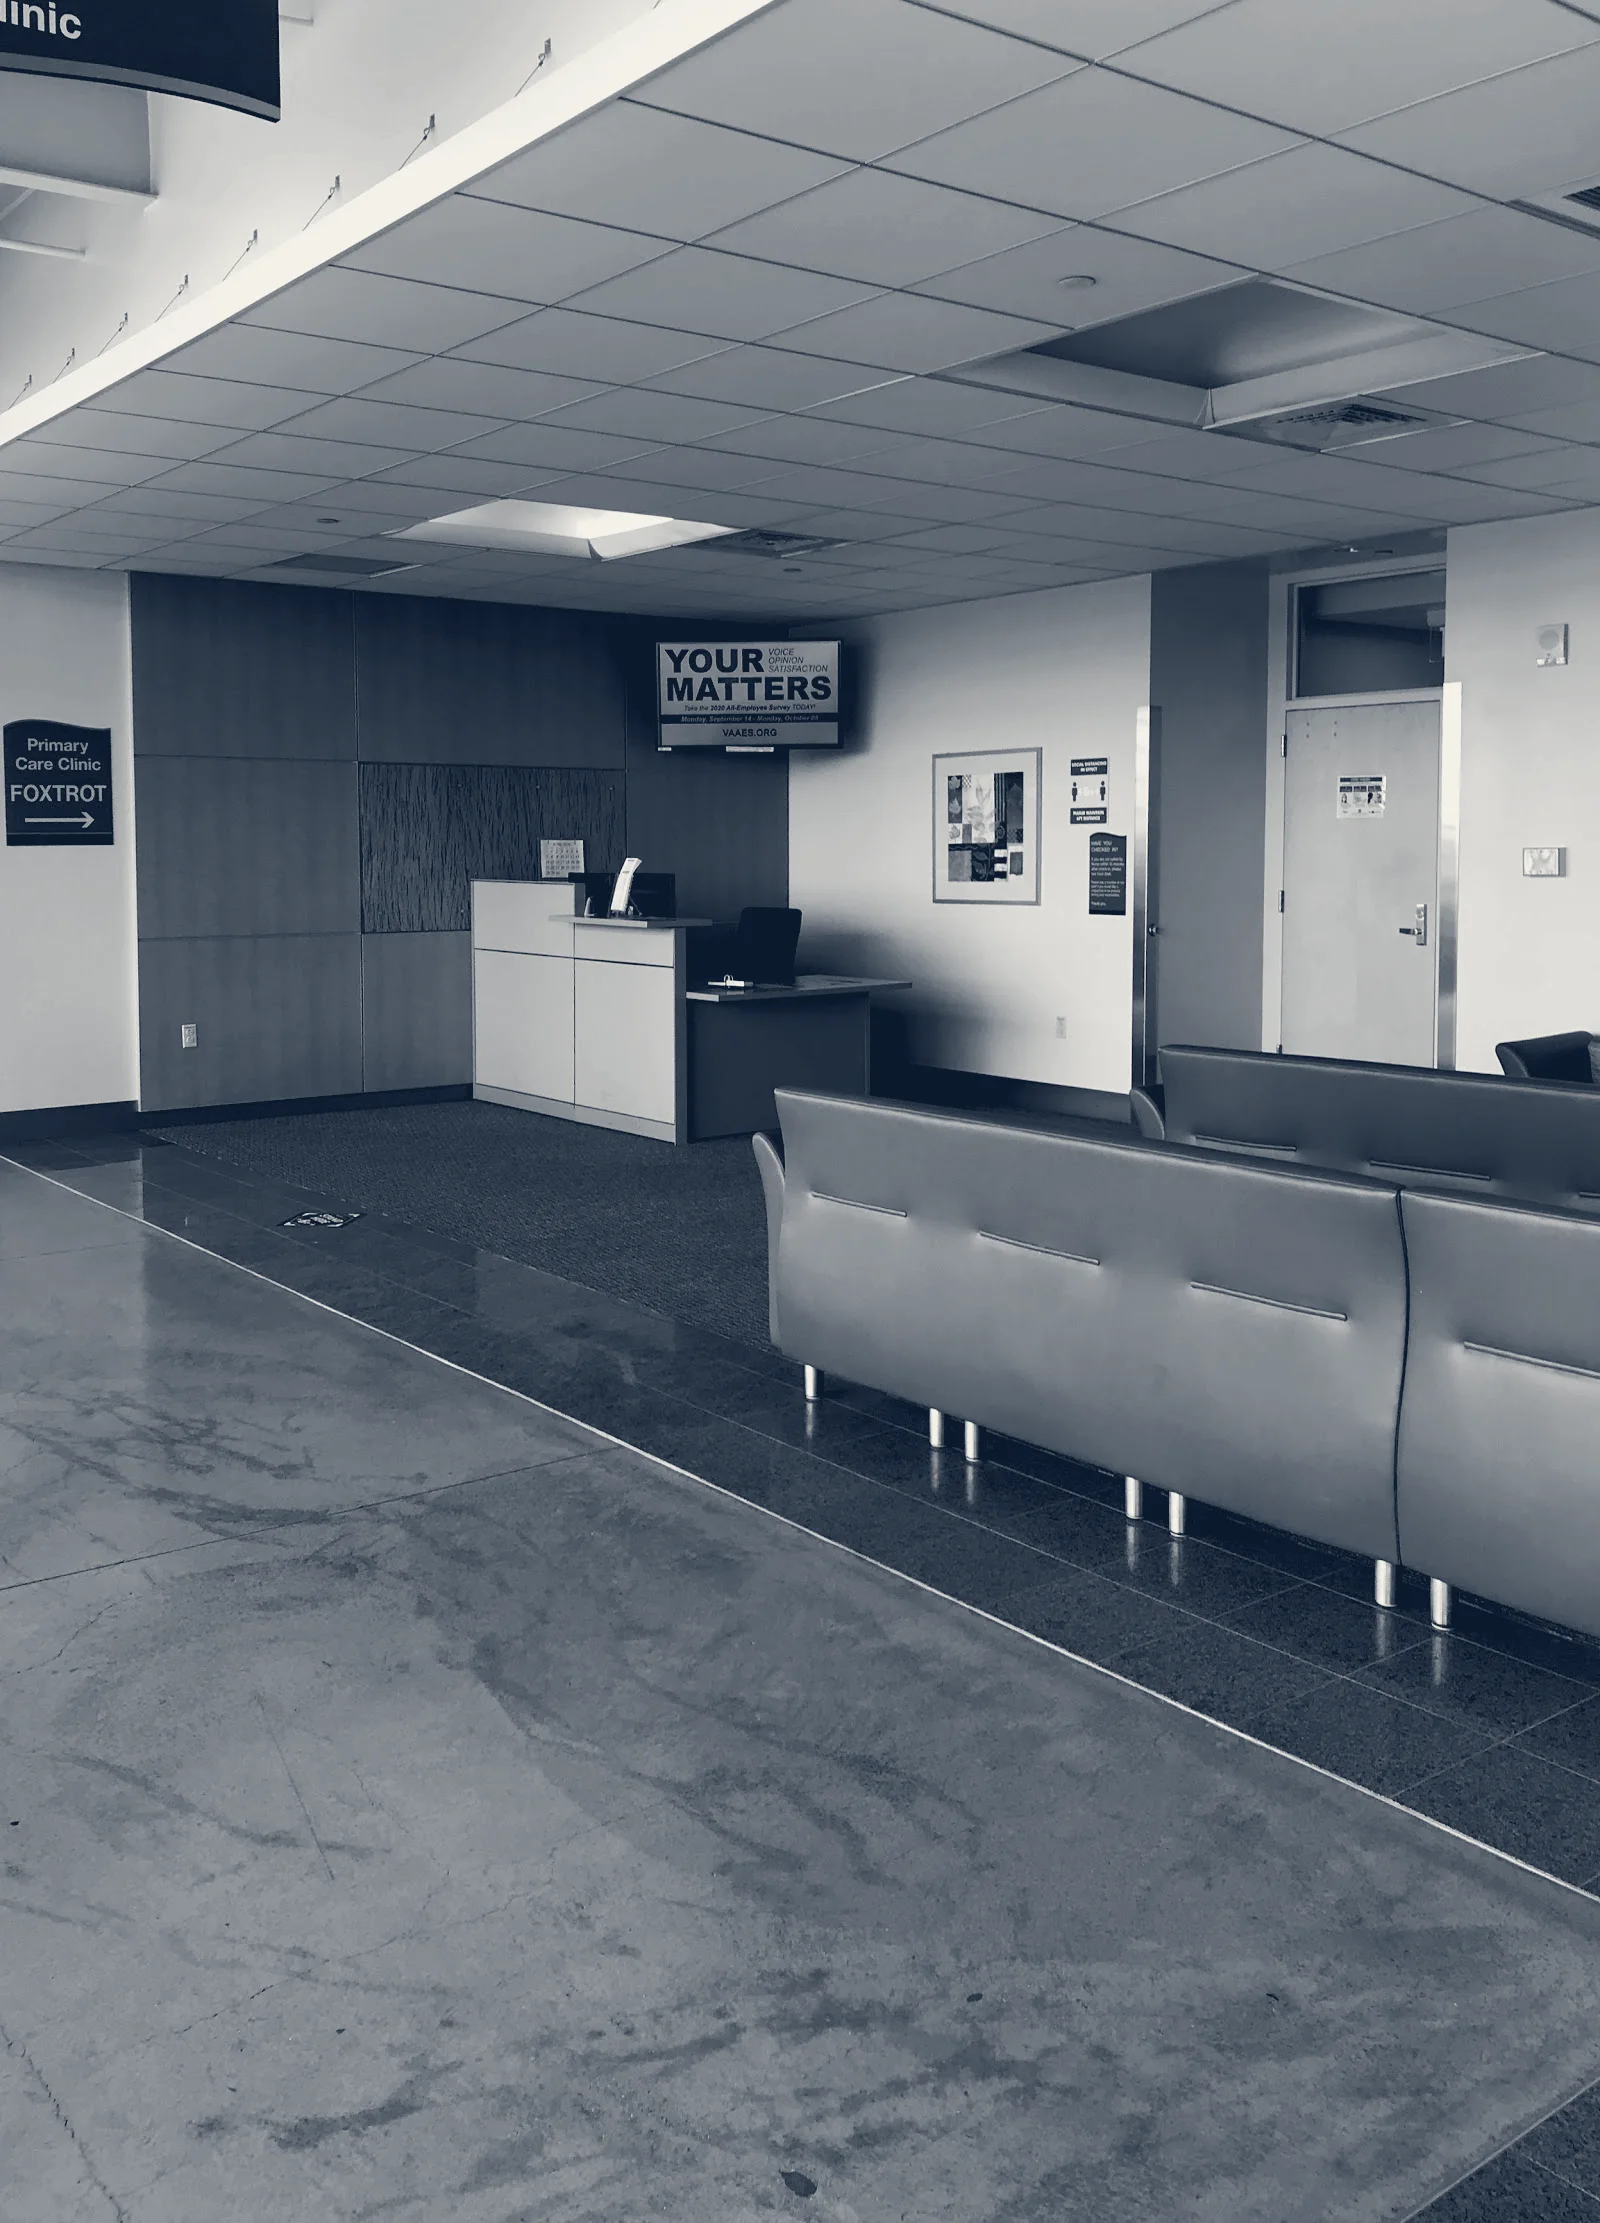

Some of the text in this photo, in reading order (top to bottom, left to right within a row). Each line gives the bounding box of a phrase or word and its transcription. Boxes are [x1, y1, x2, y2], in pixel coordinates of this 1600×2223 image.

[768, 648, 795, 656] VOICE
[665, 648, 764, 673] YOUR
[768, 656, 804, 664] OPINION
[768, 664, 829, 673] SATISFACTION
[667, 676, 832, 701] MATTERS
[726, 704, 767, 712] All-Employee
[769, 704, 791, 712] Survey
[709, 715, 743, 723] September
[784, 714, 810, 722] October
[722, 728, 778, 738] VAAES.ORG
[27, 738, 89, 755] Primary
[15, 757, 101, 771] Care Clinic
[10, 784, 107, 802] FOXTROT
